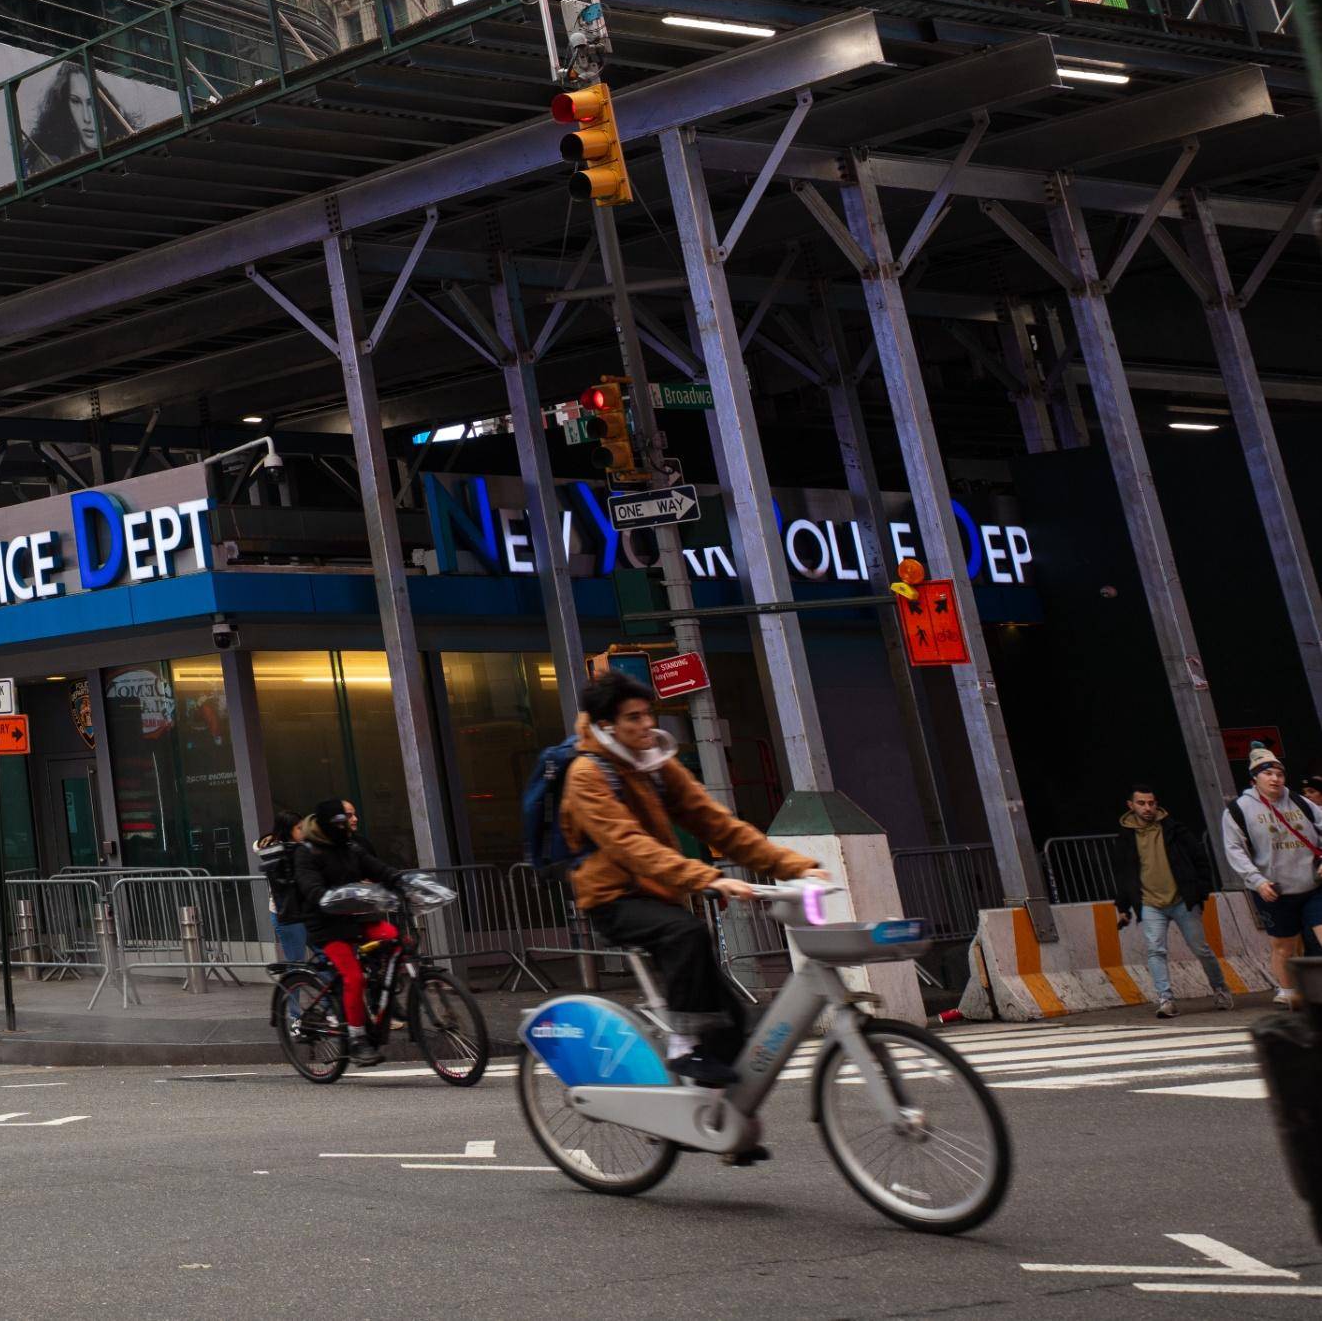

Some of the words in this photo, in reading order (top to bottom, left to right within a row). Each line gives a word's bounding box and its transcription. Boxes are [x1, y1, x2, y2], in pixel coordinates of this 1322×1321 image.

[664, 386, 714, 405] Broadwa
[618, 503, 644, 519] ONE
[657, 497, 684, 514] WAY
[70, 490, 214, 590] DEPT
[661, 658, 688, 671] STANDING
